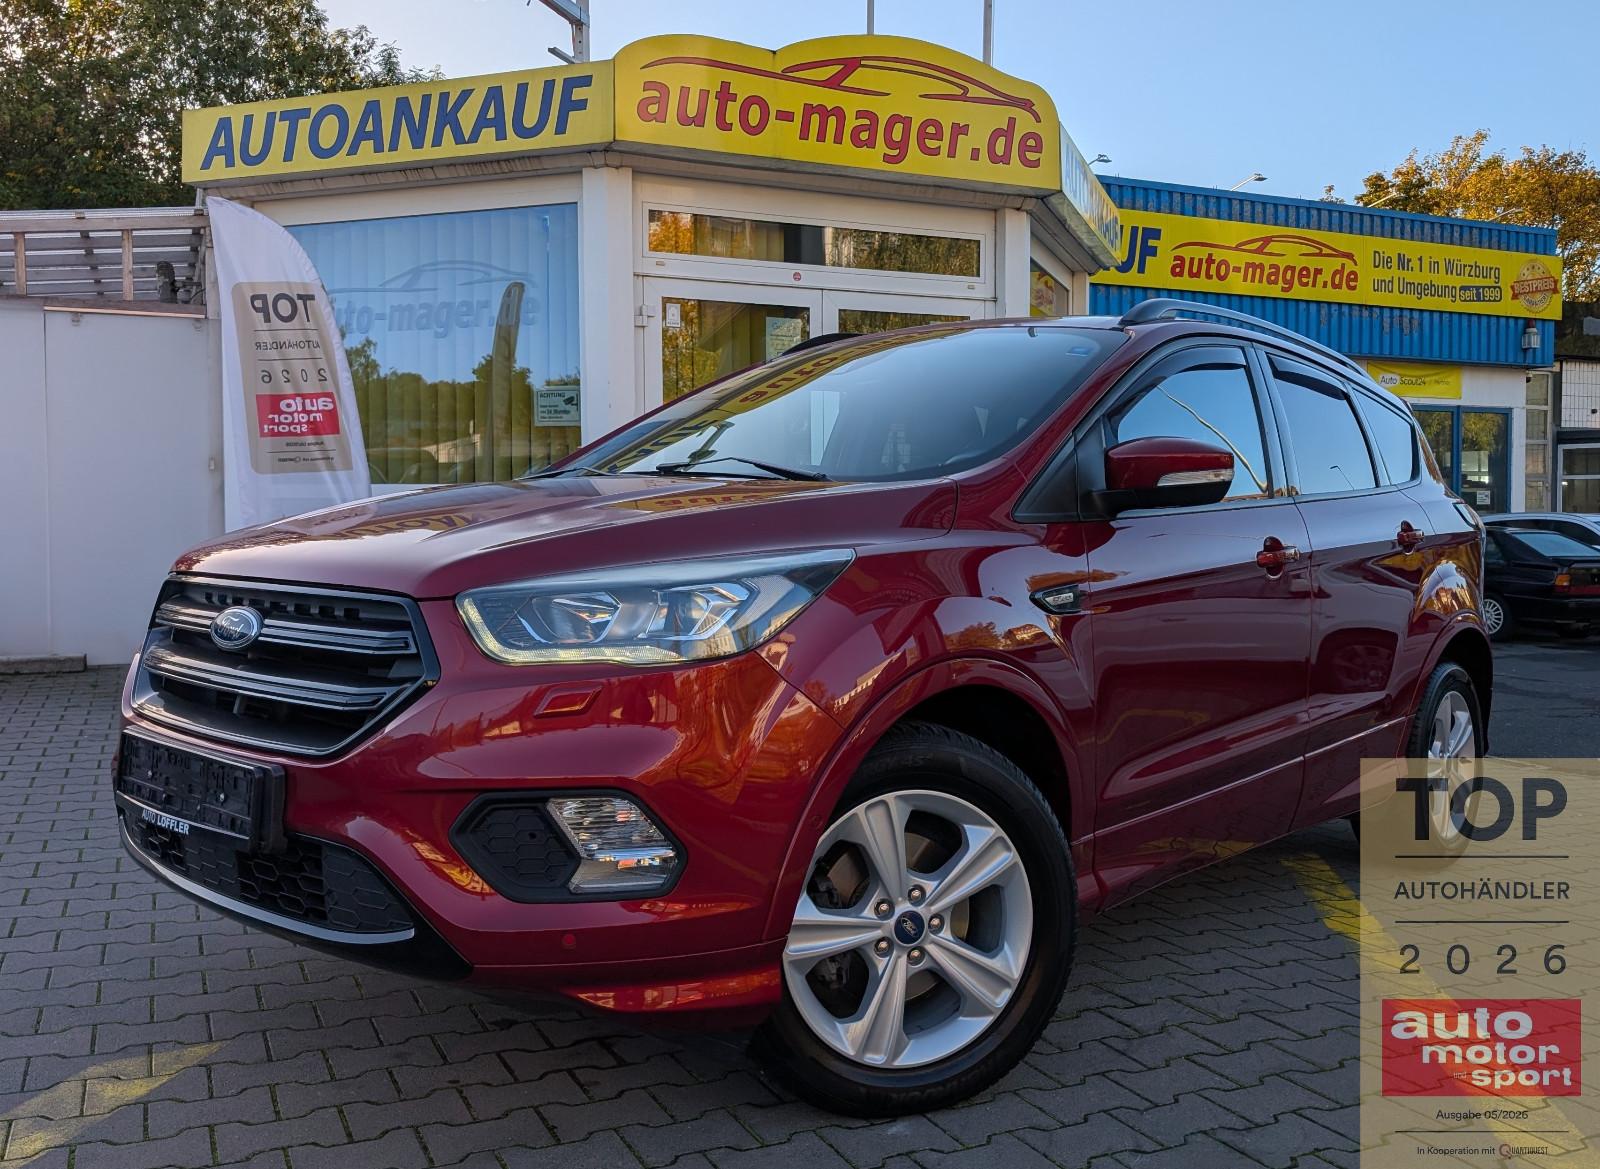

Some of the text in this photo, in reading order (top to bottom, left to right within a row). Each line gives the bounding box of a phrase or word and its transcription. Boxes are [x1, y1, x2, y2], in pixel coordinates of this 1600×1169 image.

[200, 74, 593, 171] AUTOANKAUF
[636, 80, 1044, 169] auto-mager.de
[1110, 225, 1359, 293] UF auto-mager.de
[1373, 250, 1501, 284] Die Nr. 1 in Würzburg
[1373, 276, 1501, 302] und Umgebung seit 1999
[141, 809, 156, 823] AUTO
